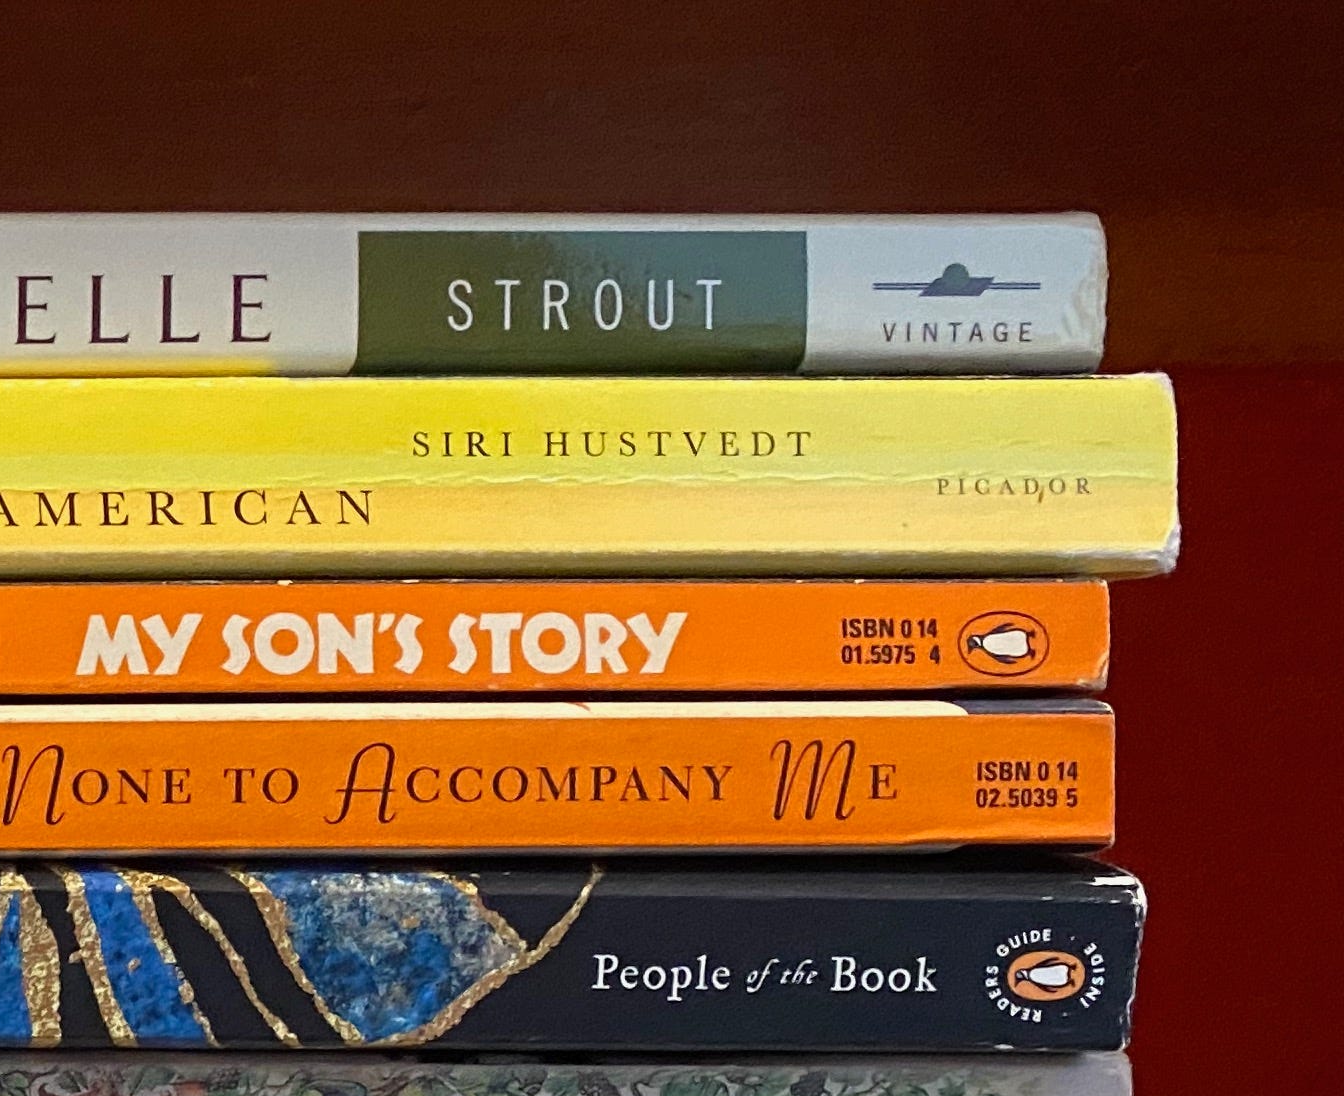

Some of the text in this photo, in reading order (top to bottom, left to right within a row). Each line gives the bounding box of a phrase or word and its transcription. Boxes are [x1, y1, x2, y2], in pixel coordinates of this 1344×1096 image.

[446, 278, 724, 331] STROUT
[882, 320, 1035, 344] VINTAGE
[411, 430, 814, 459] SIRI HUSTVEDT
[936, 477, 1094, 499] PICADOR
[842, 618, 938, 639] ISBN 0 14
[76, 611, 687, 676] MY SON'S STORY
[841, 645, 941, 665] 01.5975 4
[0, 738, 898, 828] NONE TO ACCOMPANY ME
[977, 761, 1078, 782] ISBN 0 14
[975, 787, 1078, 808] 02.5039 5
[591, 952, 939, 1003] People of the Book
[985, 928, 1052, 1023] READERS GUIDE
[1079, 942, 1106, 1009] INSIDE
